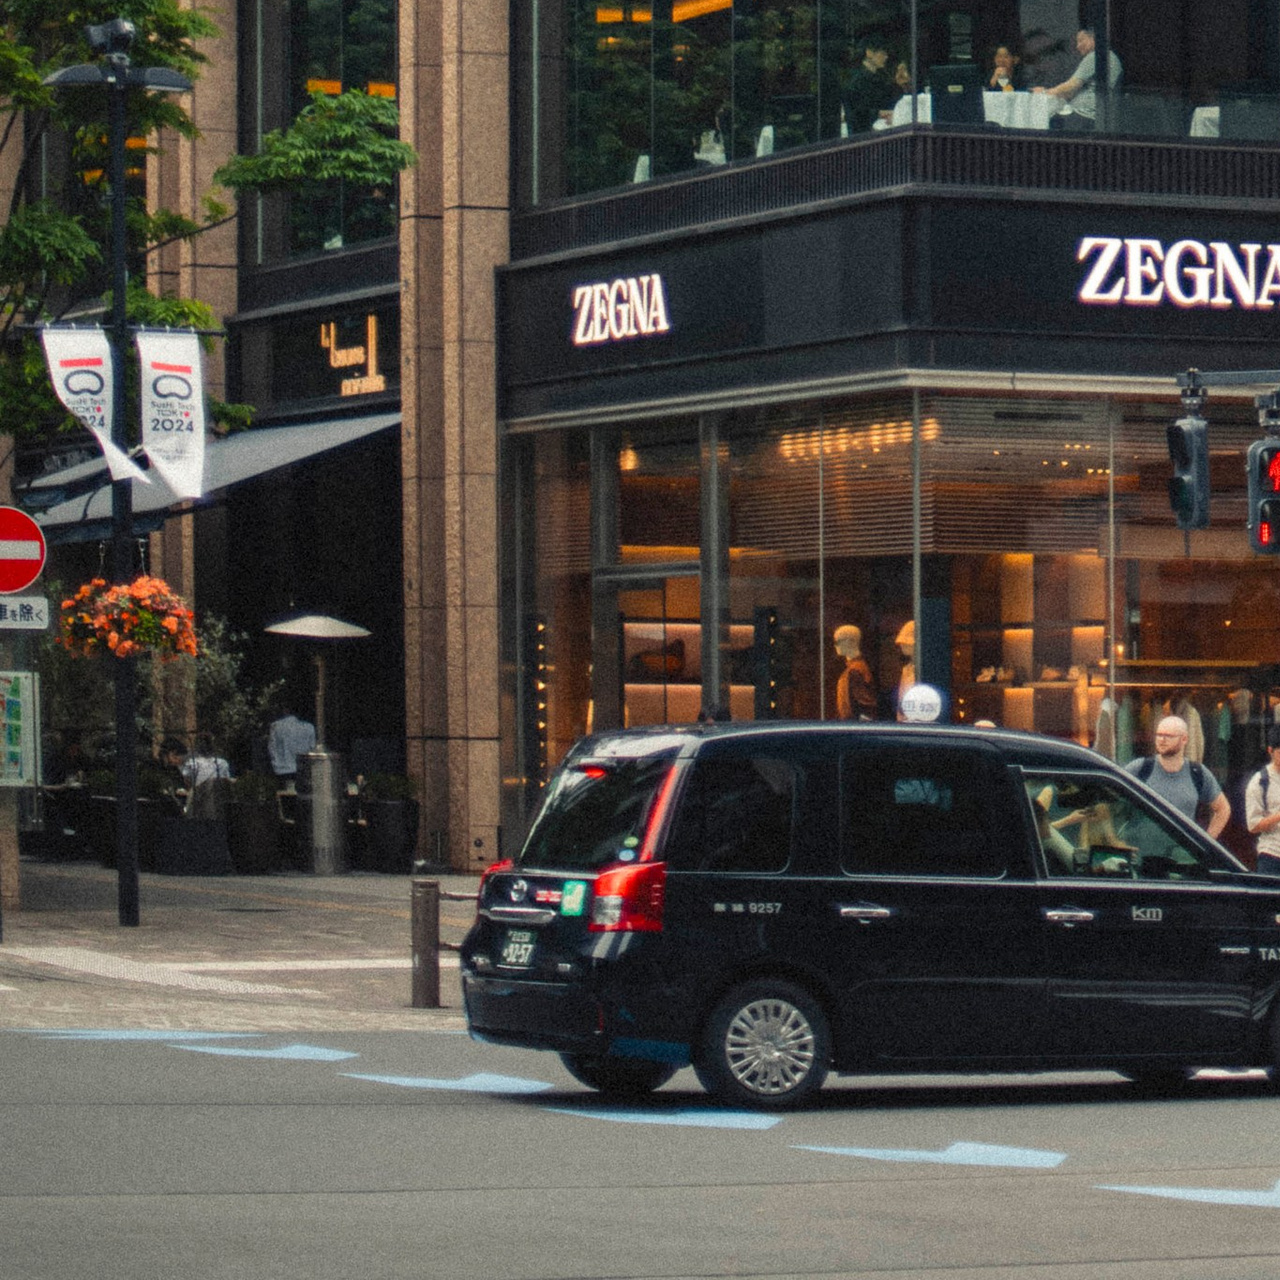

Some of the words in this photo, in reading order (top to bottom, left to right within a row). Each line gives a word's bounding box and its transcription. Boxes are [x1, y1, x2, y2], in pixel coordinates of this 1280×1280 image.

[573, 273, 670, 345] ZEGNA
[151, 418, 194, 432] 2024
[748, 902, 782, 914] 9257
[1132, 905, 1163, 920] km
